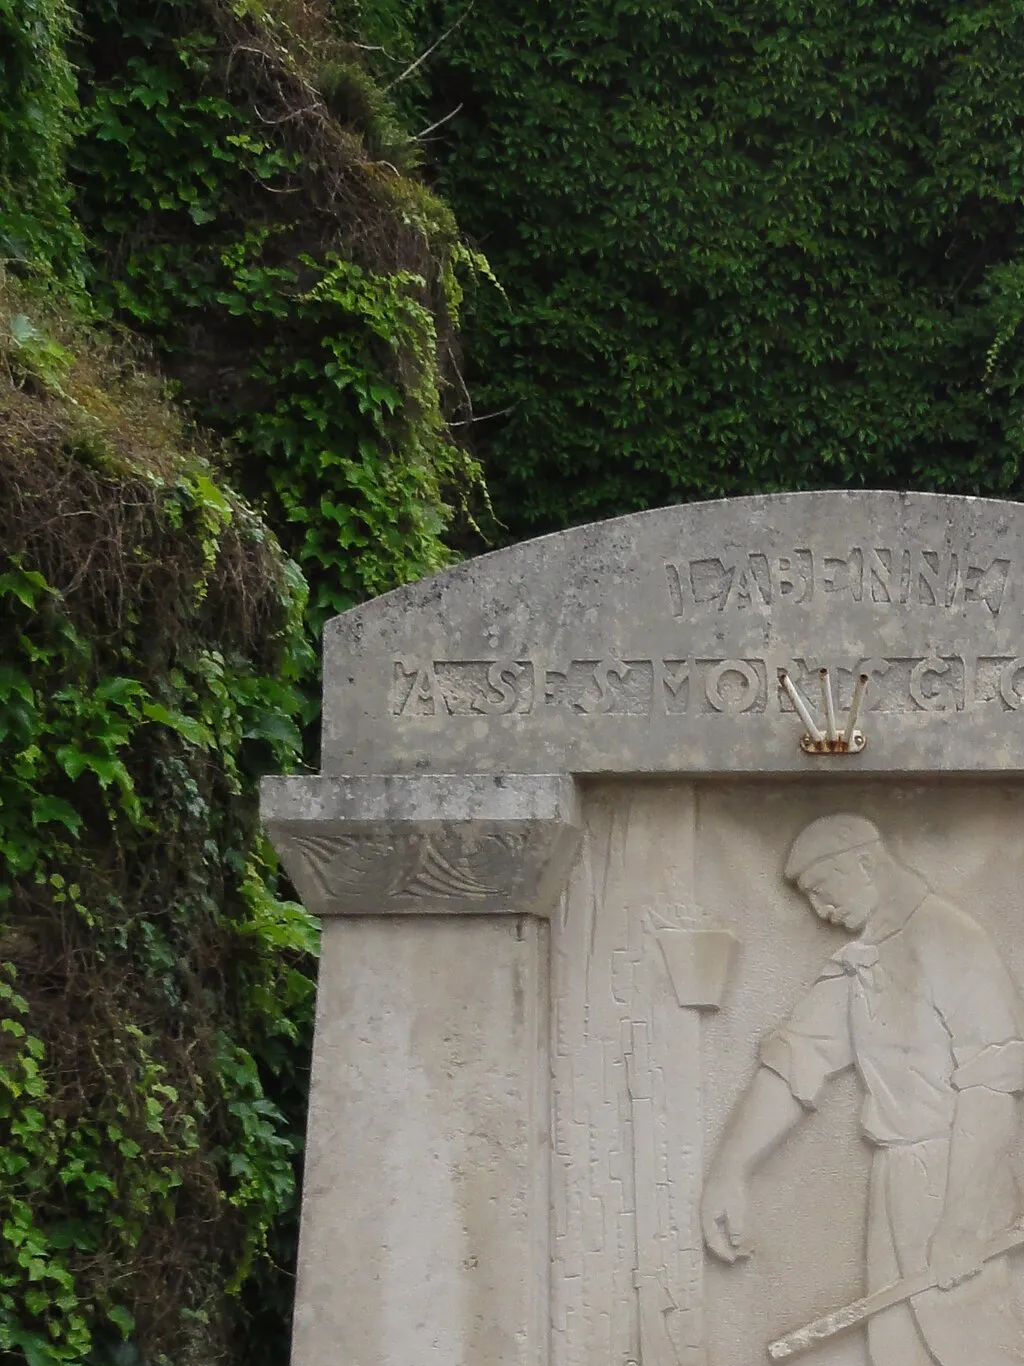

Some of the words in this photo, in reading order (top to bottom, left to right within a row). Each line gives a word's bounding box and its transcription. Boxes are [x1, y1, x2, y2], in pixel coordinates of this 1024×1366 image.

[669, 547, 1008, 615] LABENNE
[393, 659, 449, 716] A
[485, 658, 640, 716] SES
[652, 657, 892, 714] MORTS
